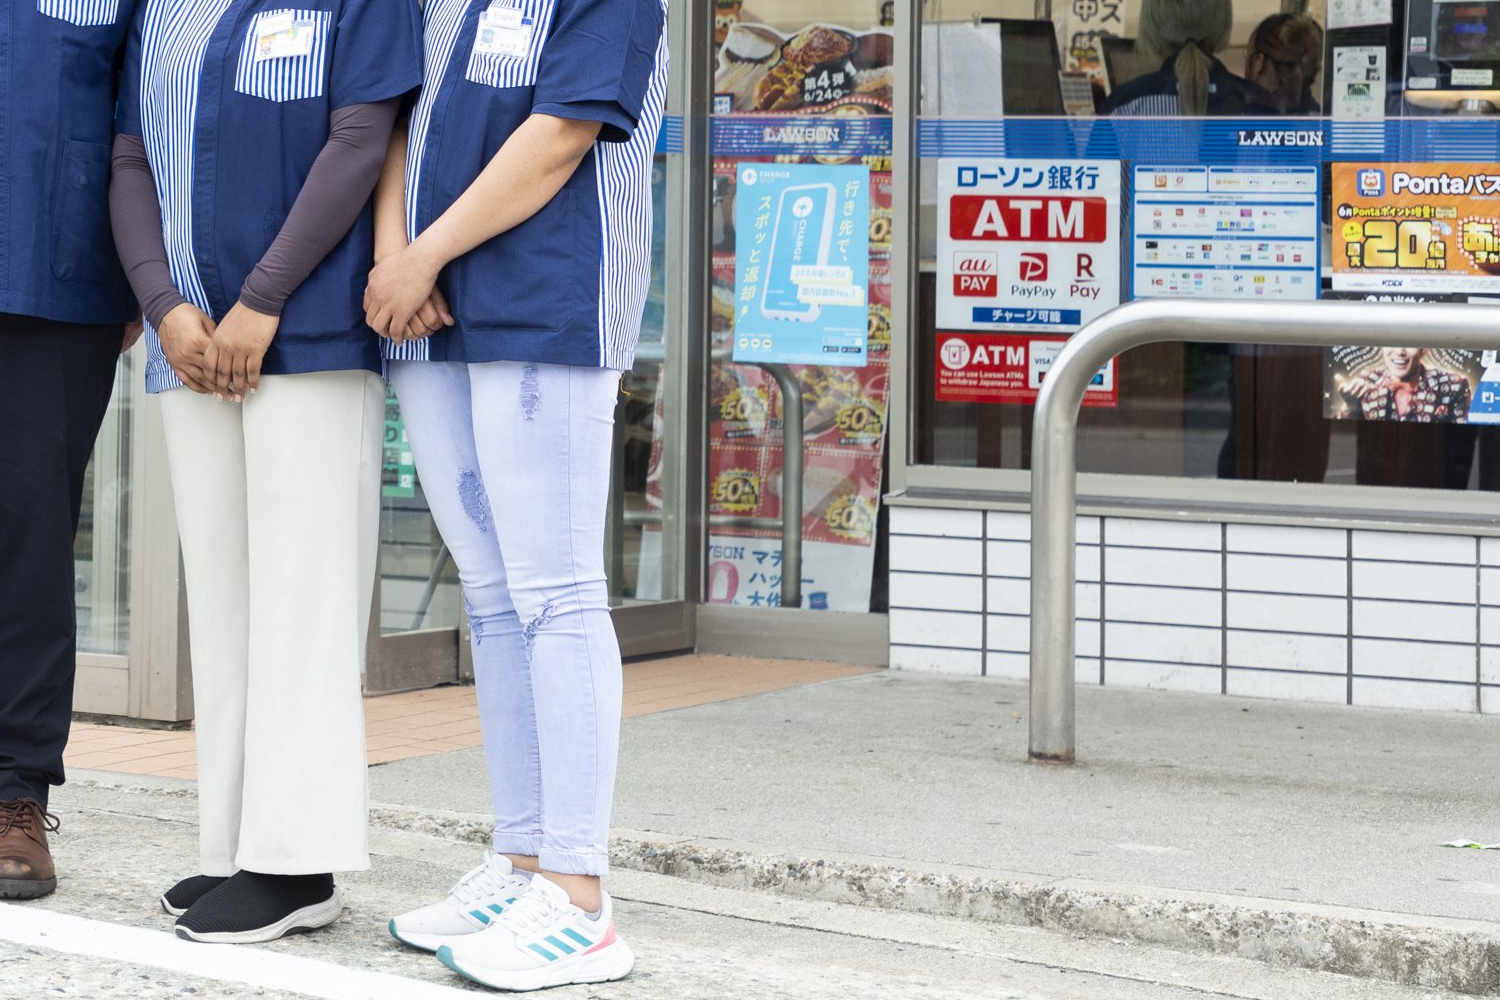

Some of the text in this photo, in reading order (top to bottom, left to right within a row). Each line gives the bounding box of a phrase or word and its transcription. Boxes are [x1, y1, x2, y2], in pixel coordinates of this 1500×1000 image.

[763, 127, 841, 144] LAWSON
[1238, 130, 1324, 147] LAWSON
[957, 165, 1100, 191] ローソン銀行
[1393, 171, 1500, 196] Pontaパス
[971, 198, 1086, 240] ATM
[959, 258, 992, 272] au
[1076, 253, 1095, 278] R
[960, 276, 991, 292] PAY
[1011, 284, 1057, 299] PayPay
[1070, 284, 1101, 301] Pay
[991, 309, 1062, 324] チャージ可能
[971, 345, 1026, 366] ATM
[1034, 357, 1051, 365] VISA
[940, 370, 954, 378] You
[979, 370, 1005, 379] Lawson
[947, 378, 978, 386] withdraw
[978, 379, 1009, 388] Japanese
[709, 546, 745, 560] SON
[749, 572, 814, 588] ハッー
